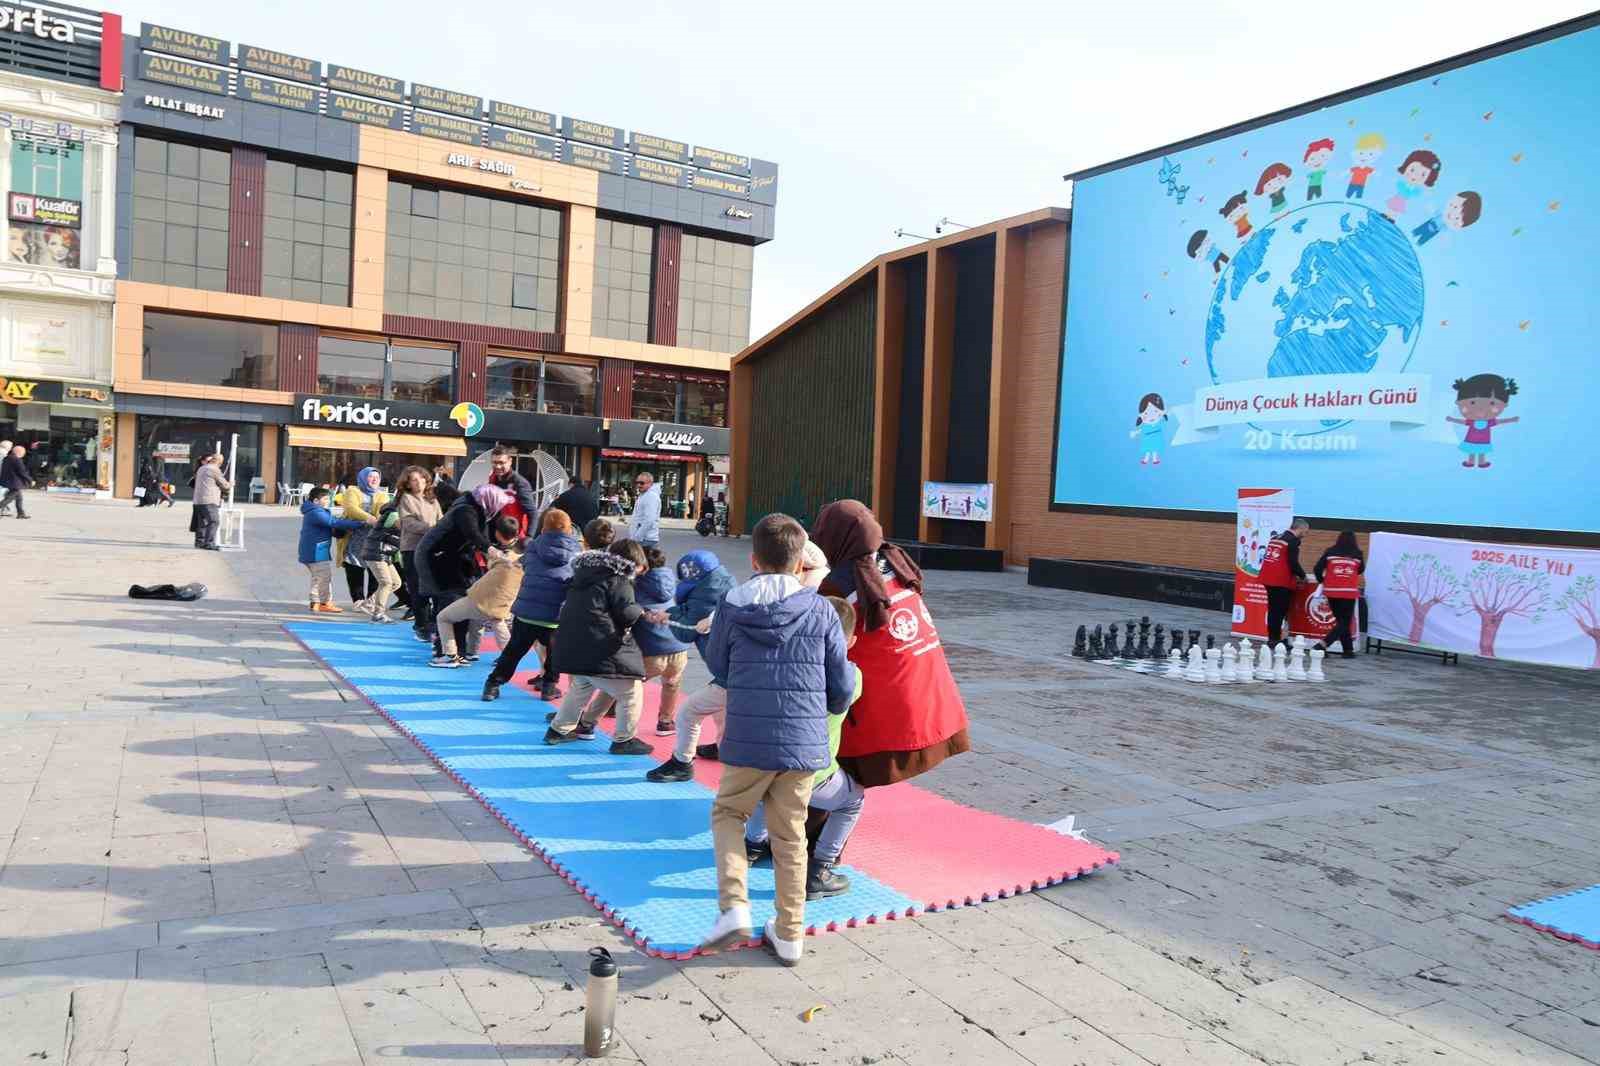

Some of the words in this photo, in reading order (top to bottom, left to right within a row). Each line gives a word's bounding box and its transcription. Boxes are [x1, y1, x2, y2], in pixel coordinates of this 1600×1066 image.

[150, 26, 221, 51] AVUKAT
[149, 57, 221, 81] AVUKAT
[247, 47, 313, 71] AVUKAT
[243, 77, 262, 91] ER
[335, 67, 398, 90] AVUKAT
[145, 94, 180, 111] POLAT
[335, 96, 398, 118] AVUKAT
[1205, 396, 1248, 415] Dünya
[1253, 393, 1298, 413] Çocuk
[1304, 390, 1362, 408] Hakları
[1368, 387, 1418, 405] Günü
[390, 417, 440, 430] COFFEE
[1244, 432, 1271, 450] 20
[1280, 432, 1357, 450] Kasım
[1472, 550, 1504, 563] 2025
